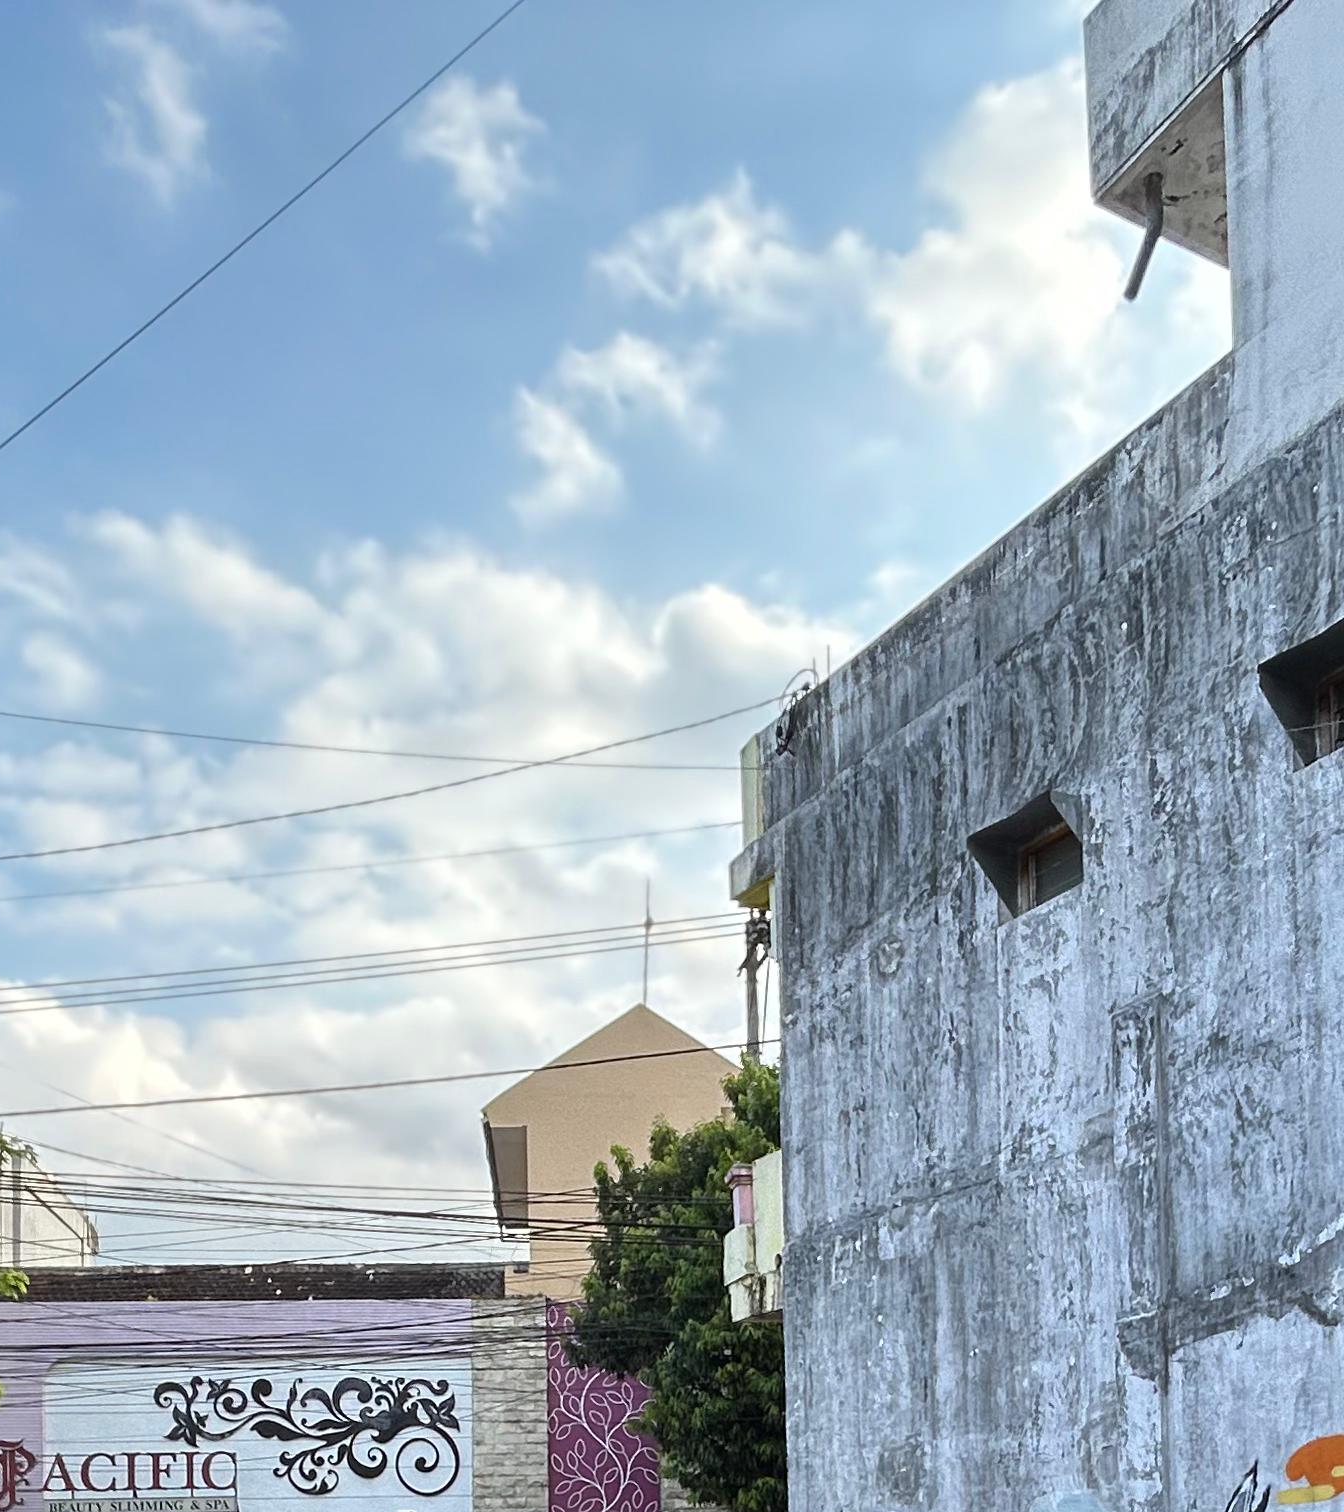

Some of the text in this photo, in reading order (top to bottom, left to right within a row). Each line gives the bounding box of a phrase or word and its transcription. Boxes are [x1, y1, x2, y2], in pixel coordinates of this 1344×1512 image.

[109, 1500, 184, 1512] SLIMMING
[190, 1499, 201, 1511] &
[206, 1499, 231, 1511] SPA
